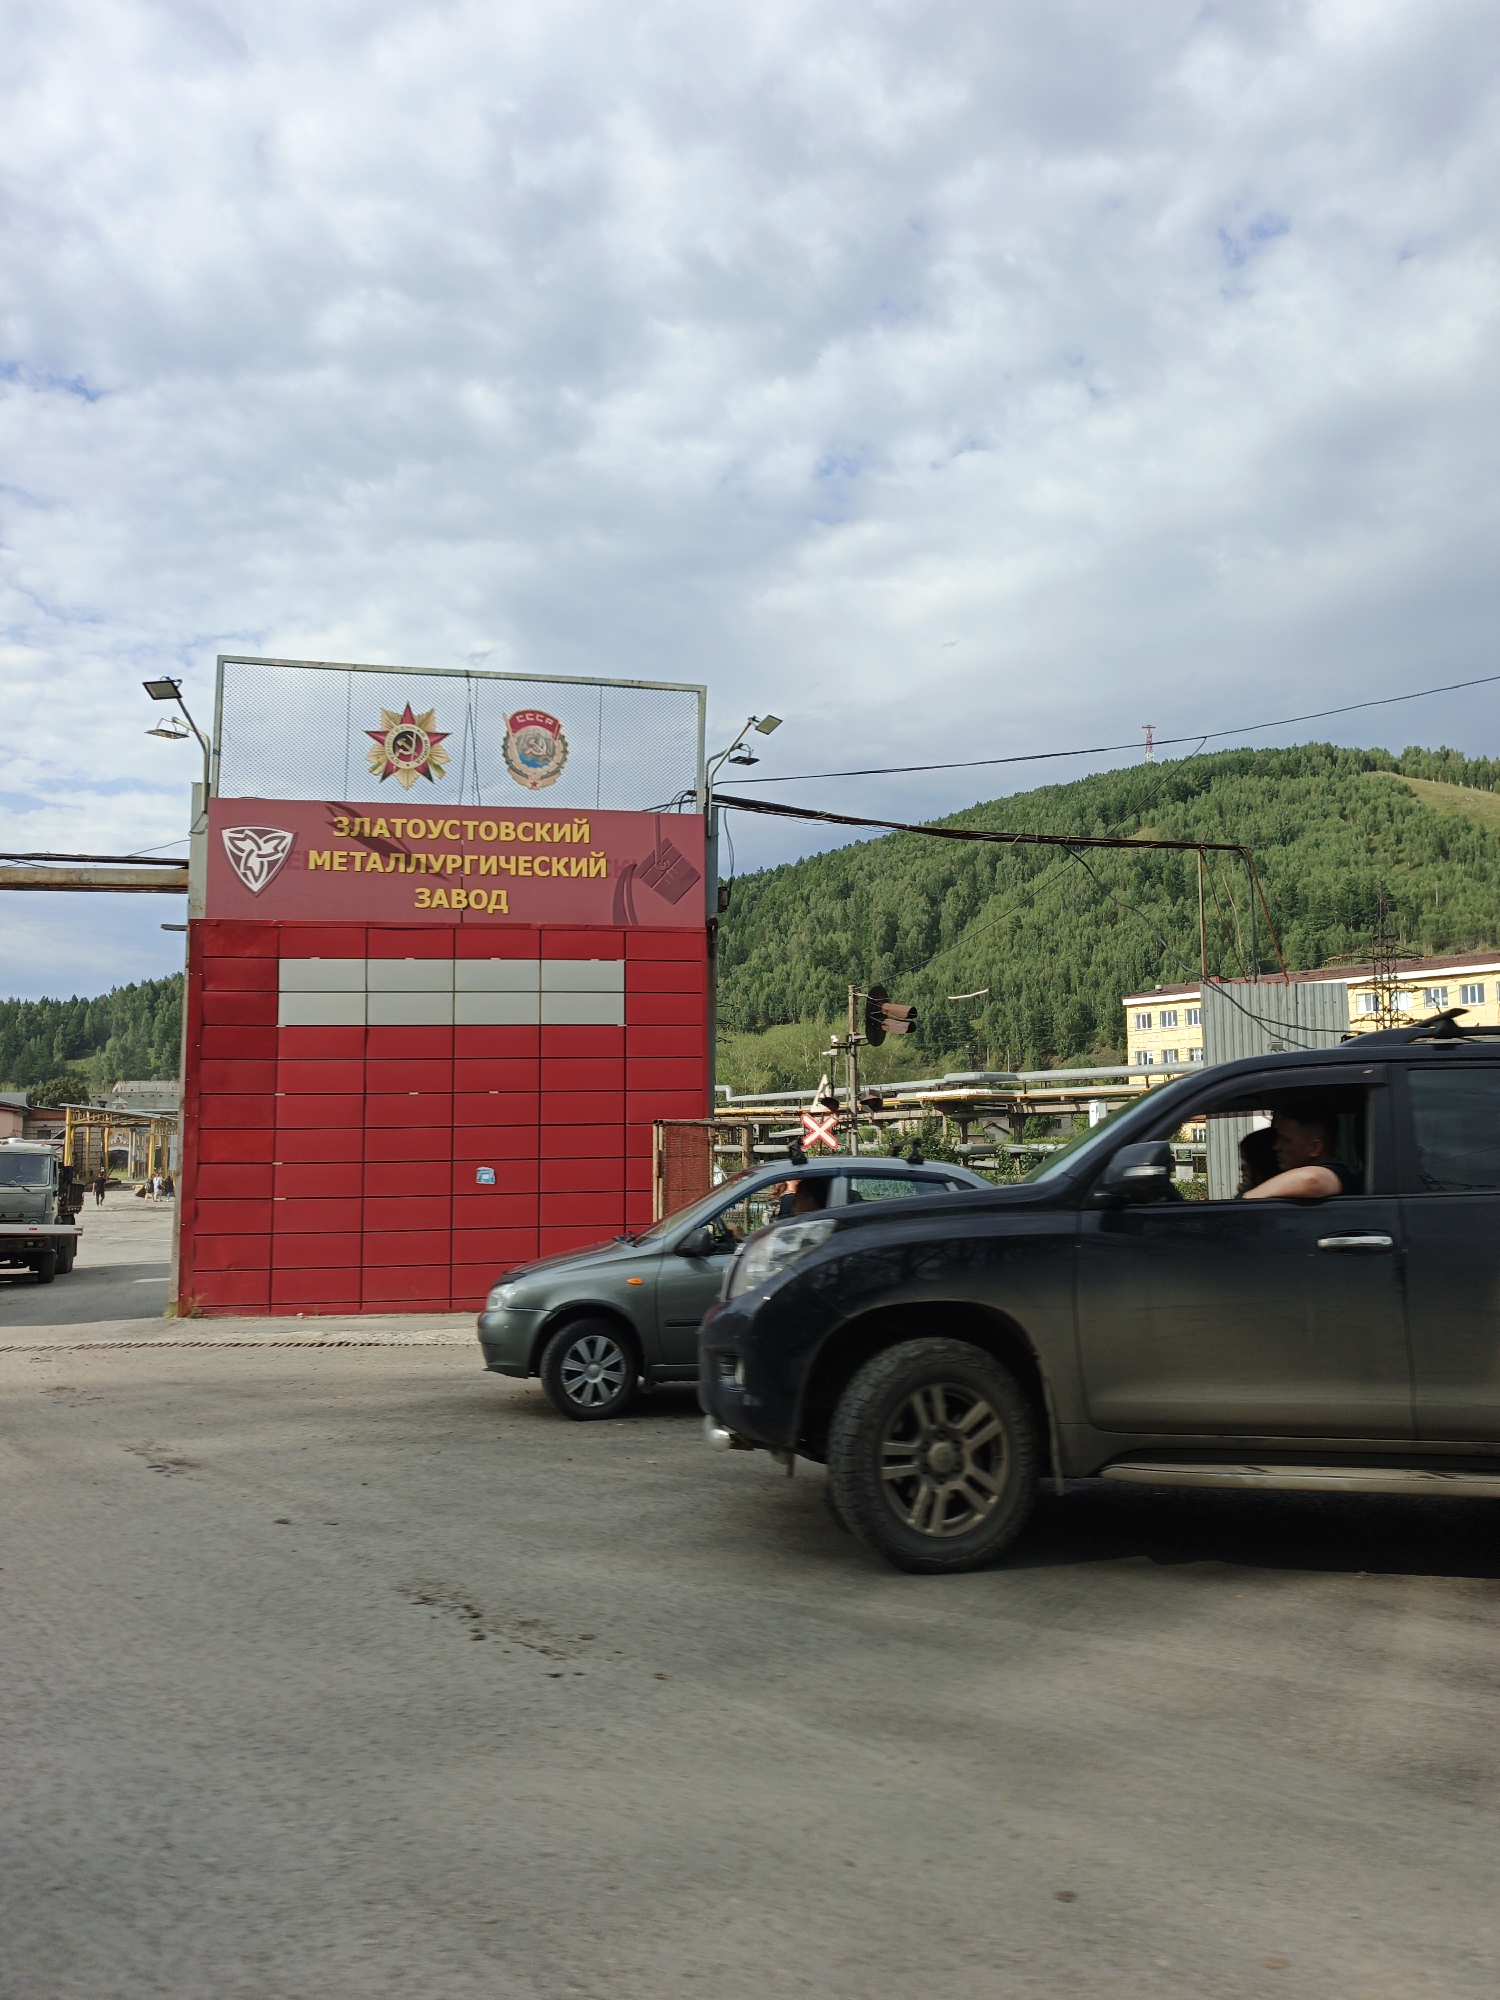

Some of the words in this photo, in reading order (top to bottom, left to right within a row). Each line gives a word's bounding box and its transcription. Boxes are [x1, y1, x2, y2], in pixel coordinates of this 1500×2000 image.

[515, 712, 554, 726] СССР
[333, 815, 590, 845] ЗЛАТОУСТОВСКИЙ
[308, 849, 607, 880] МЕТАЛЛУРГИЧЕСКИЙ
[413, 886, 509, 915] ЗАВОД
